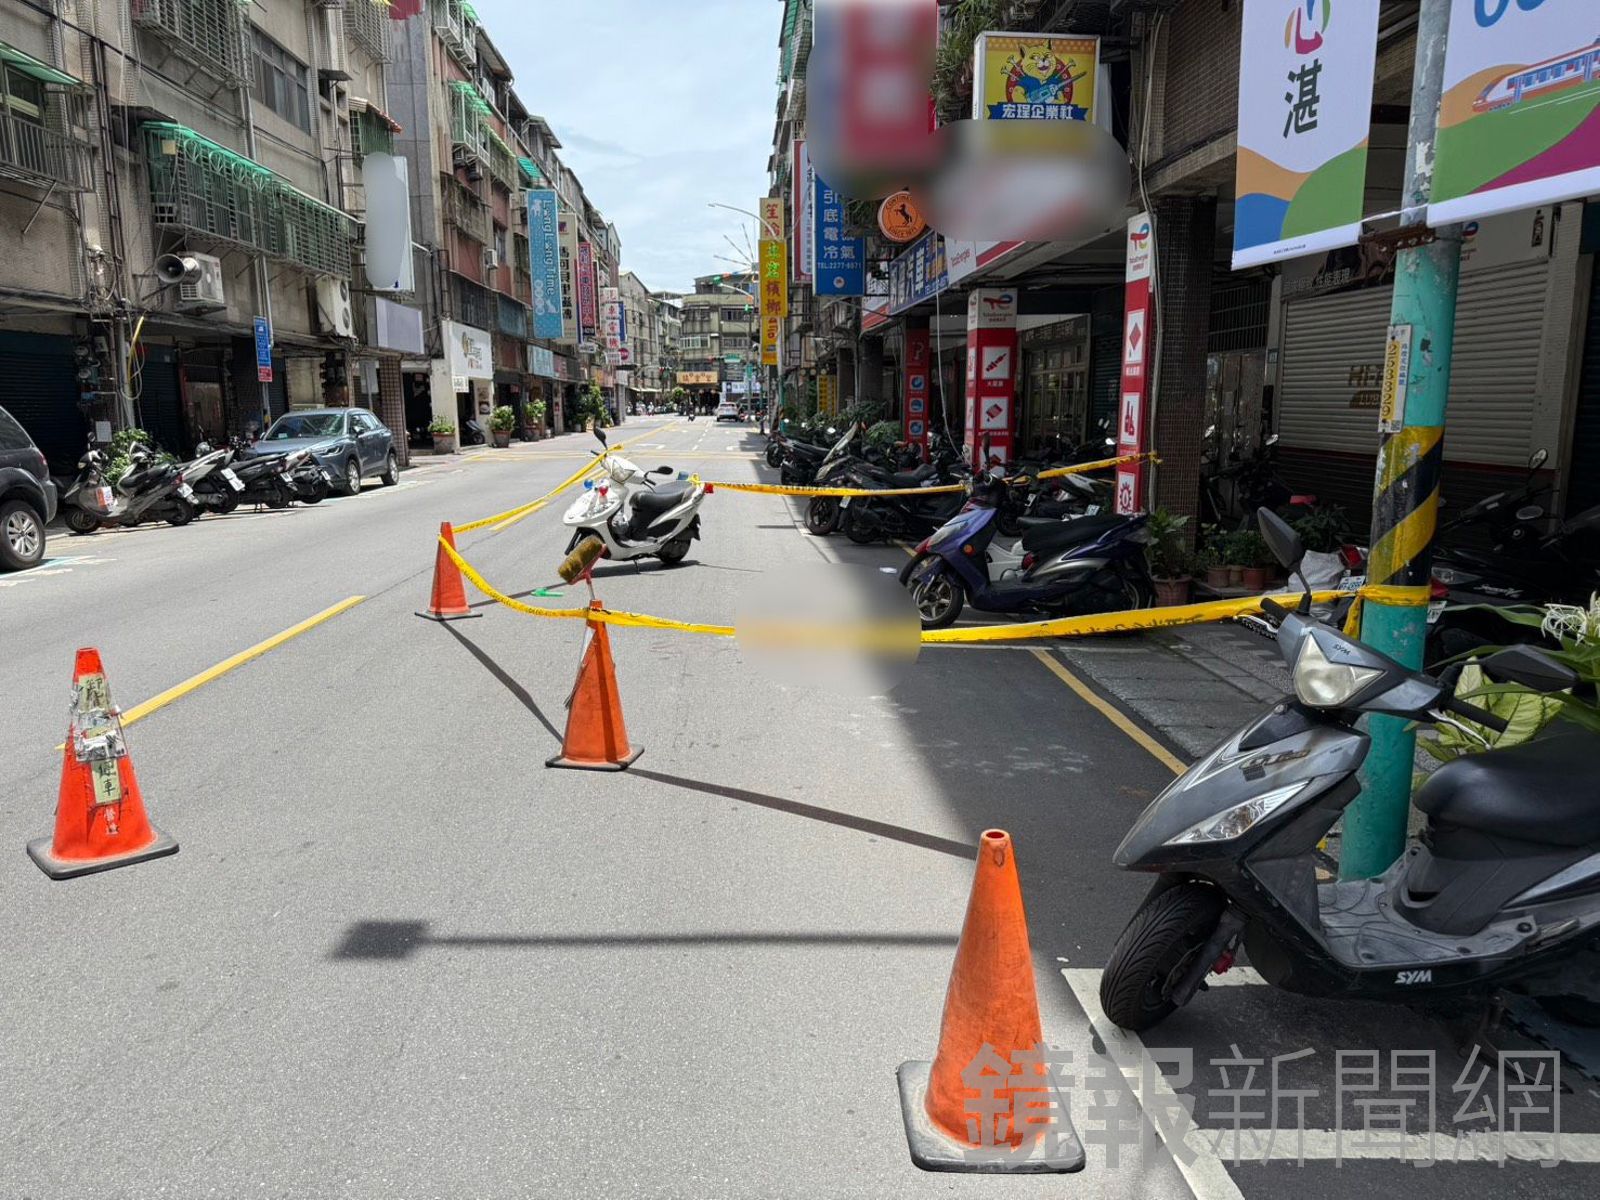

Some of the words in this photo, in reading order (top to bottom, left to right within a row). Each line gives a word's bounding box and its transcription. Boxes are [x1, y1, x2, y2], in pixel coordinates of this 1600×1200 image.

[1283, 58, 1323, 139] 湛
[1381, 343, 1398, 417] 253329
[1332, 643, 1352, 656] SYM
[1394, 969, 1432, 985] SYM
